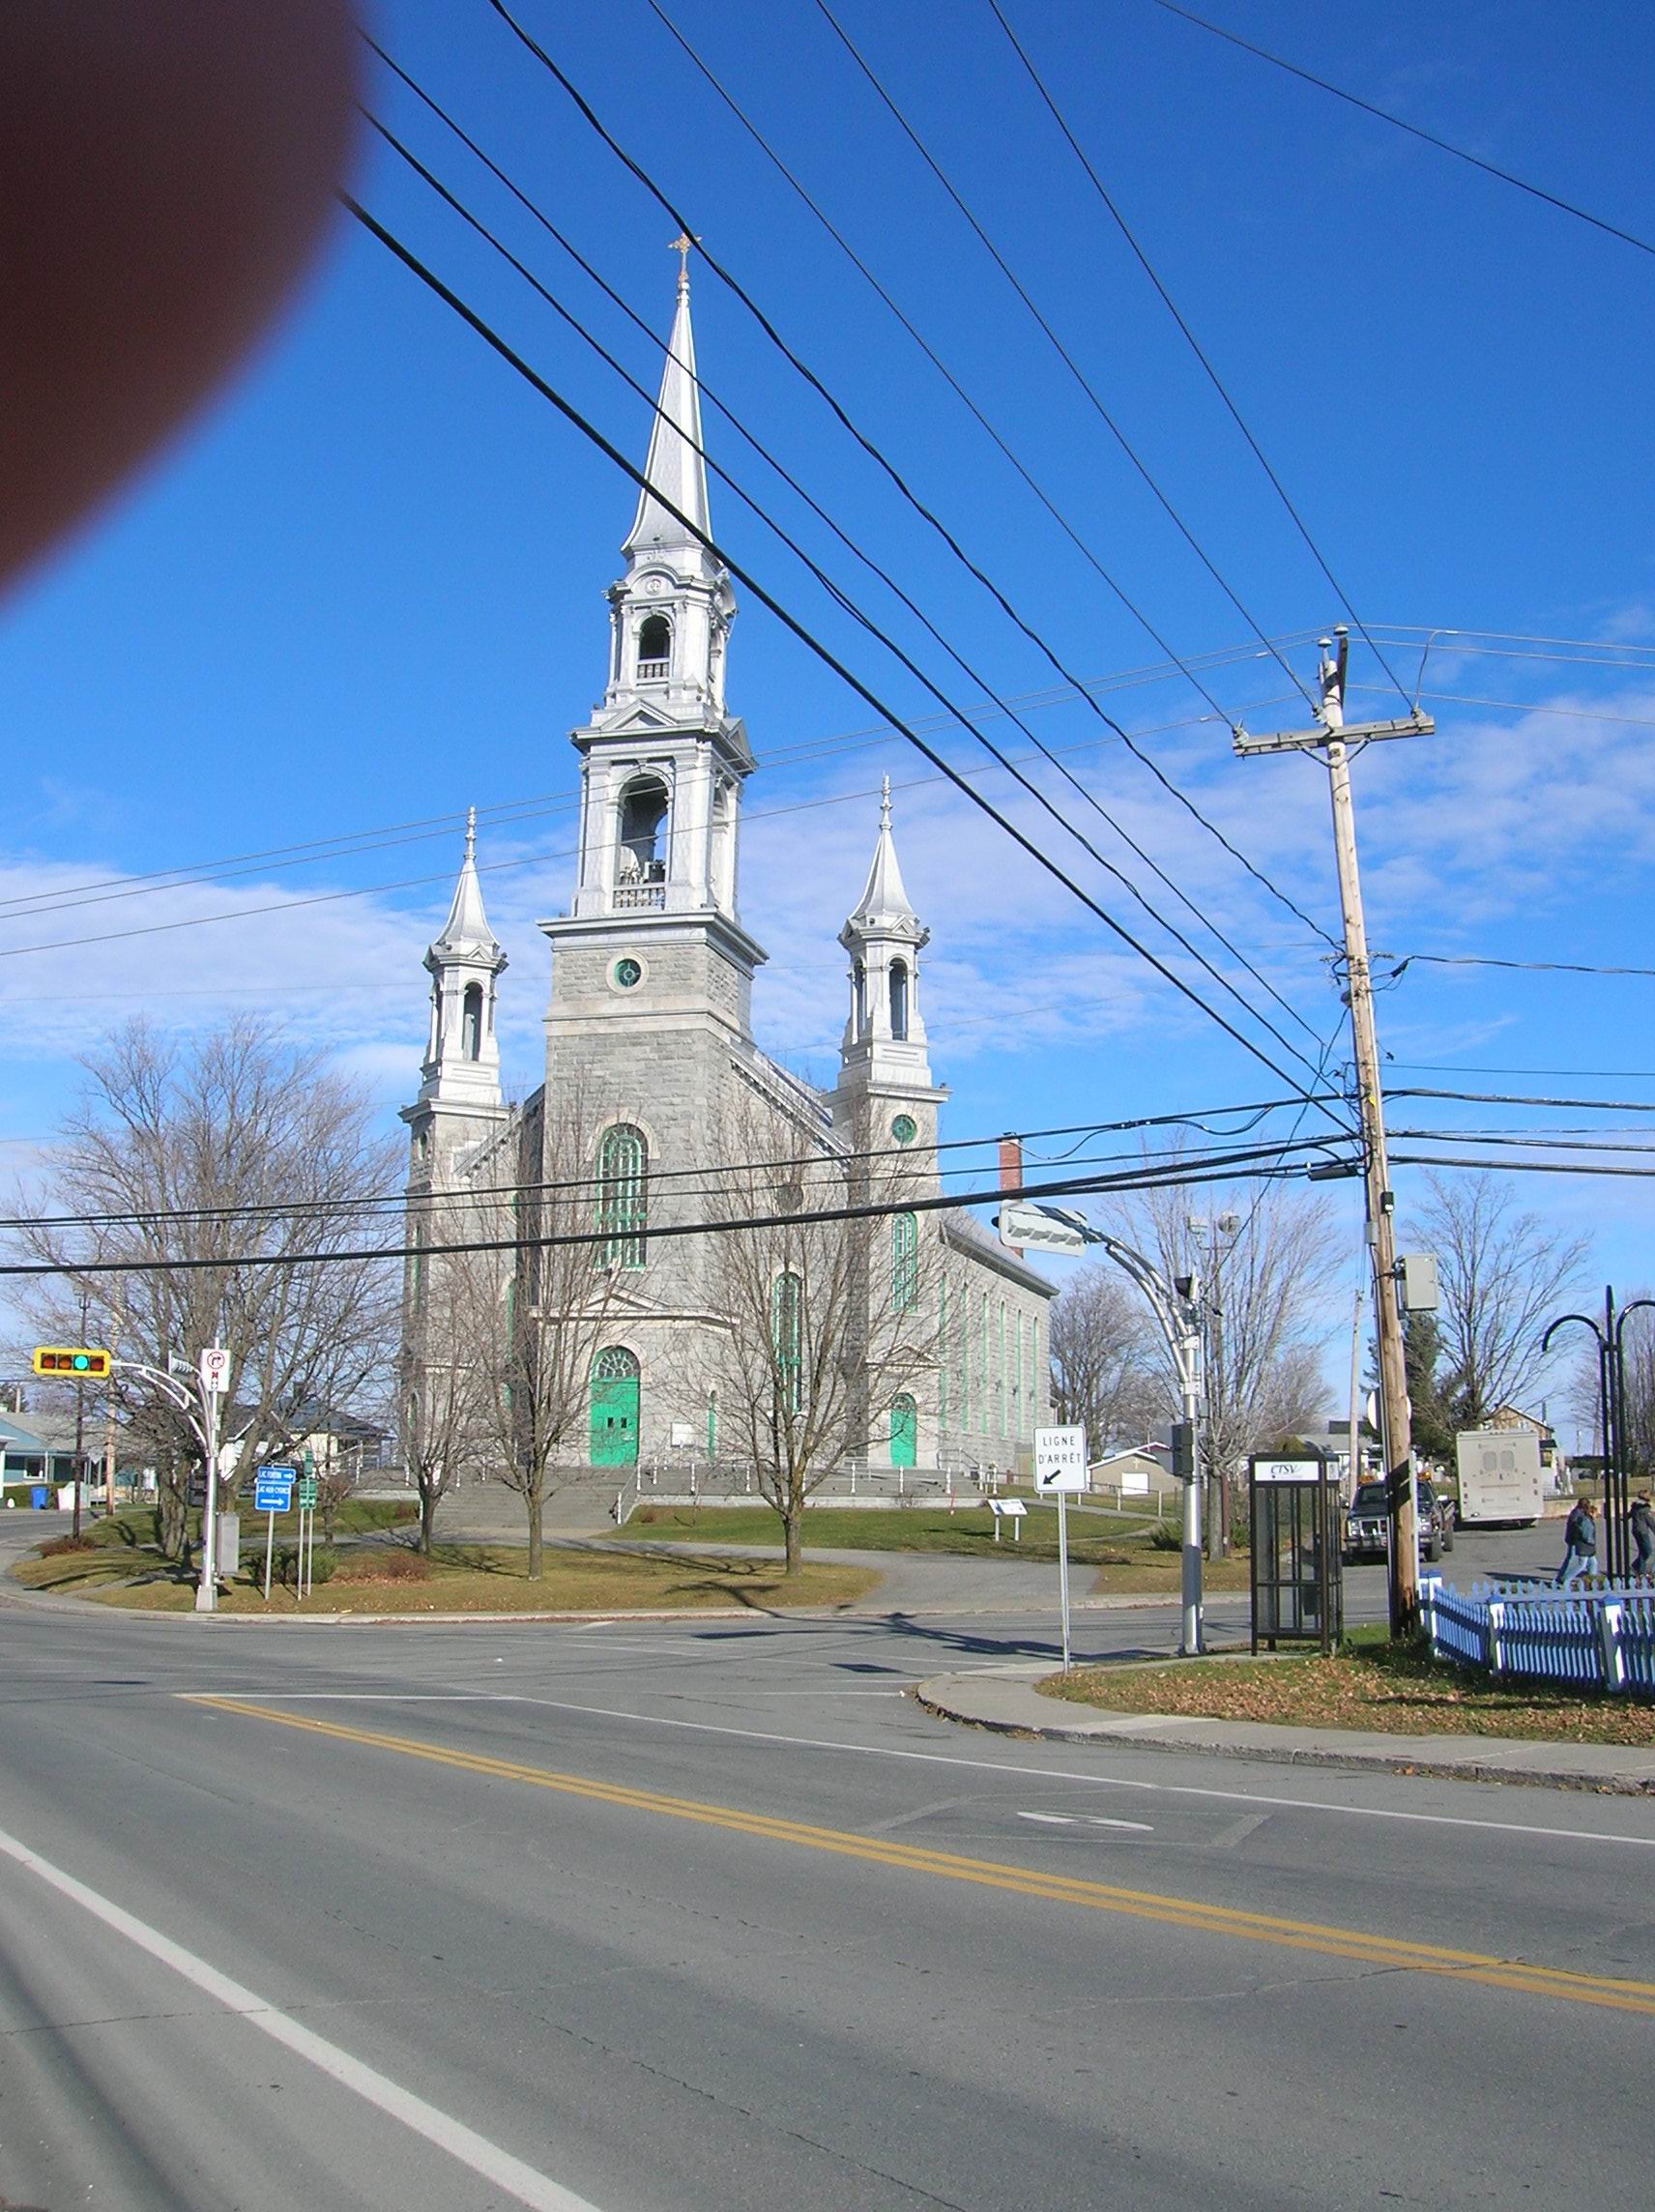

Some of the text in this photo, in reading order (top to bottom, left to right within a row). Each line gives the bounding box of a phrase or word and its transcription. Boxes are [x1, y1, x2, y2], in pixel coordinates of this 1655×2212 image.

[1043, 1436, 1075, 1446] LIGNE
[1038, 1452, 1081, 1464] D'ARRÊT
[1270, 1464, 1296, 1473] CTSV
